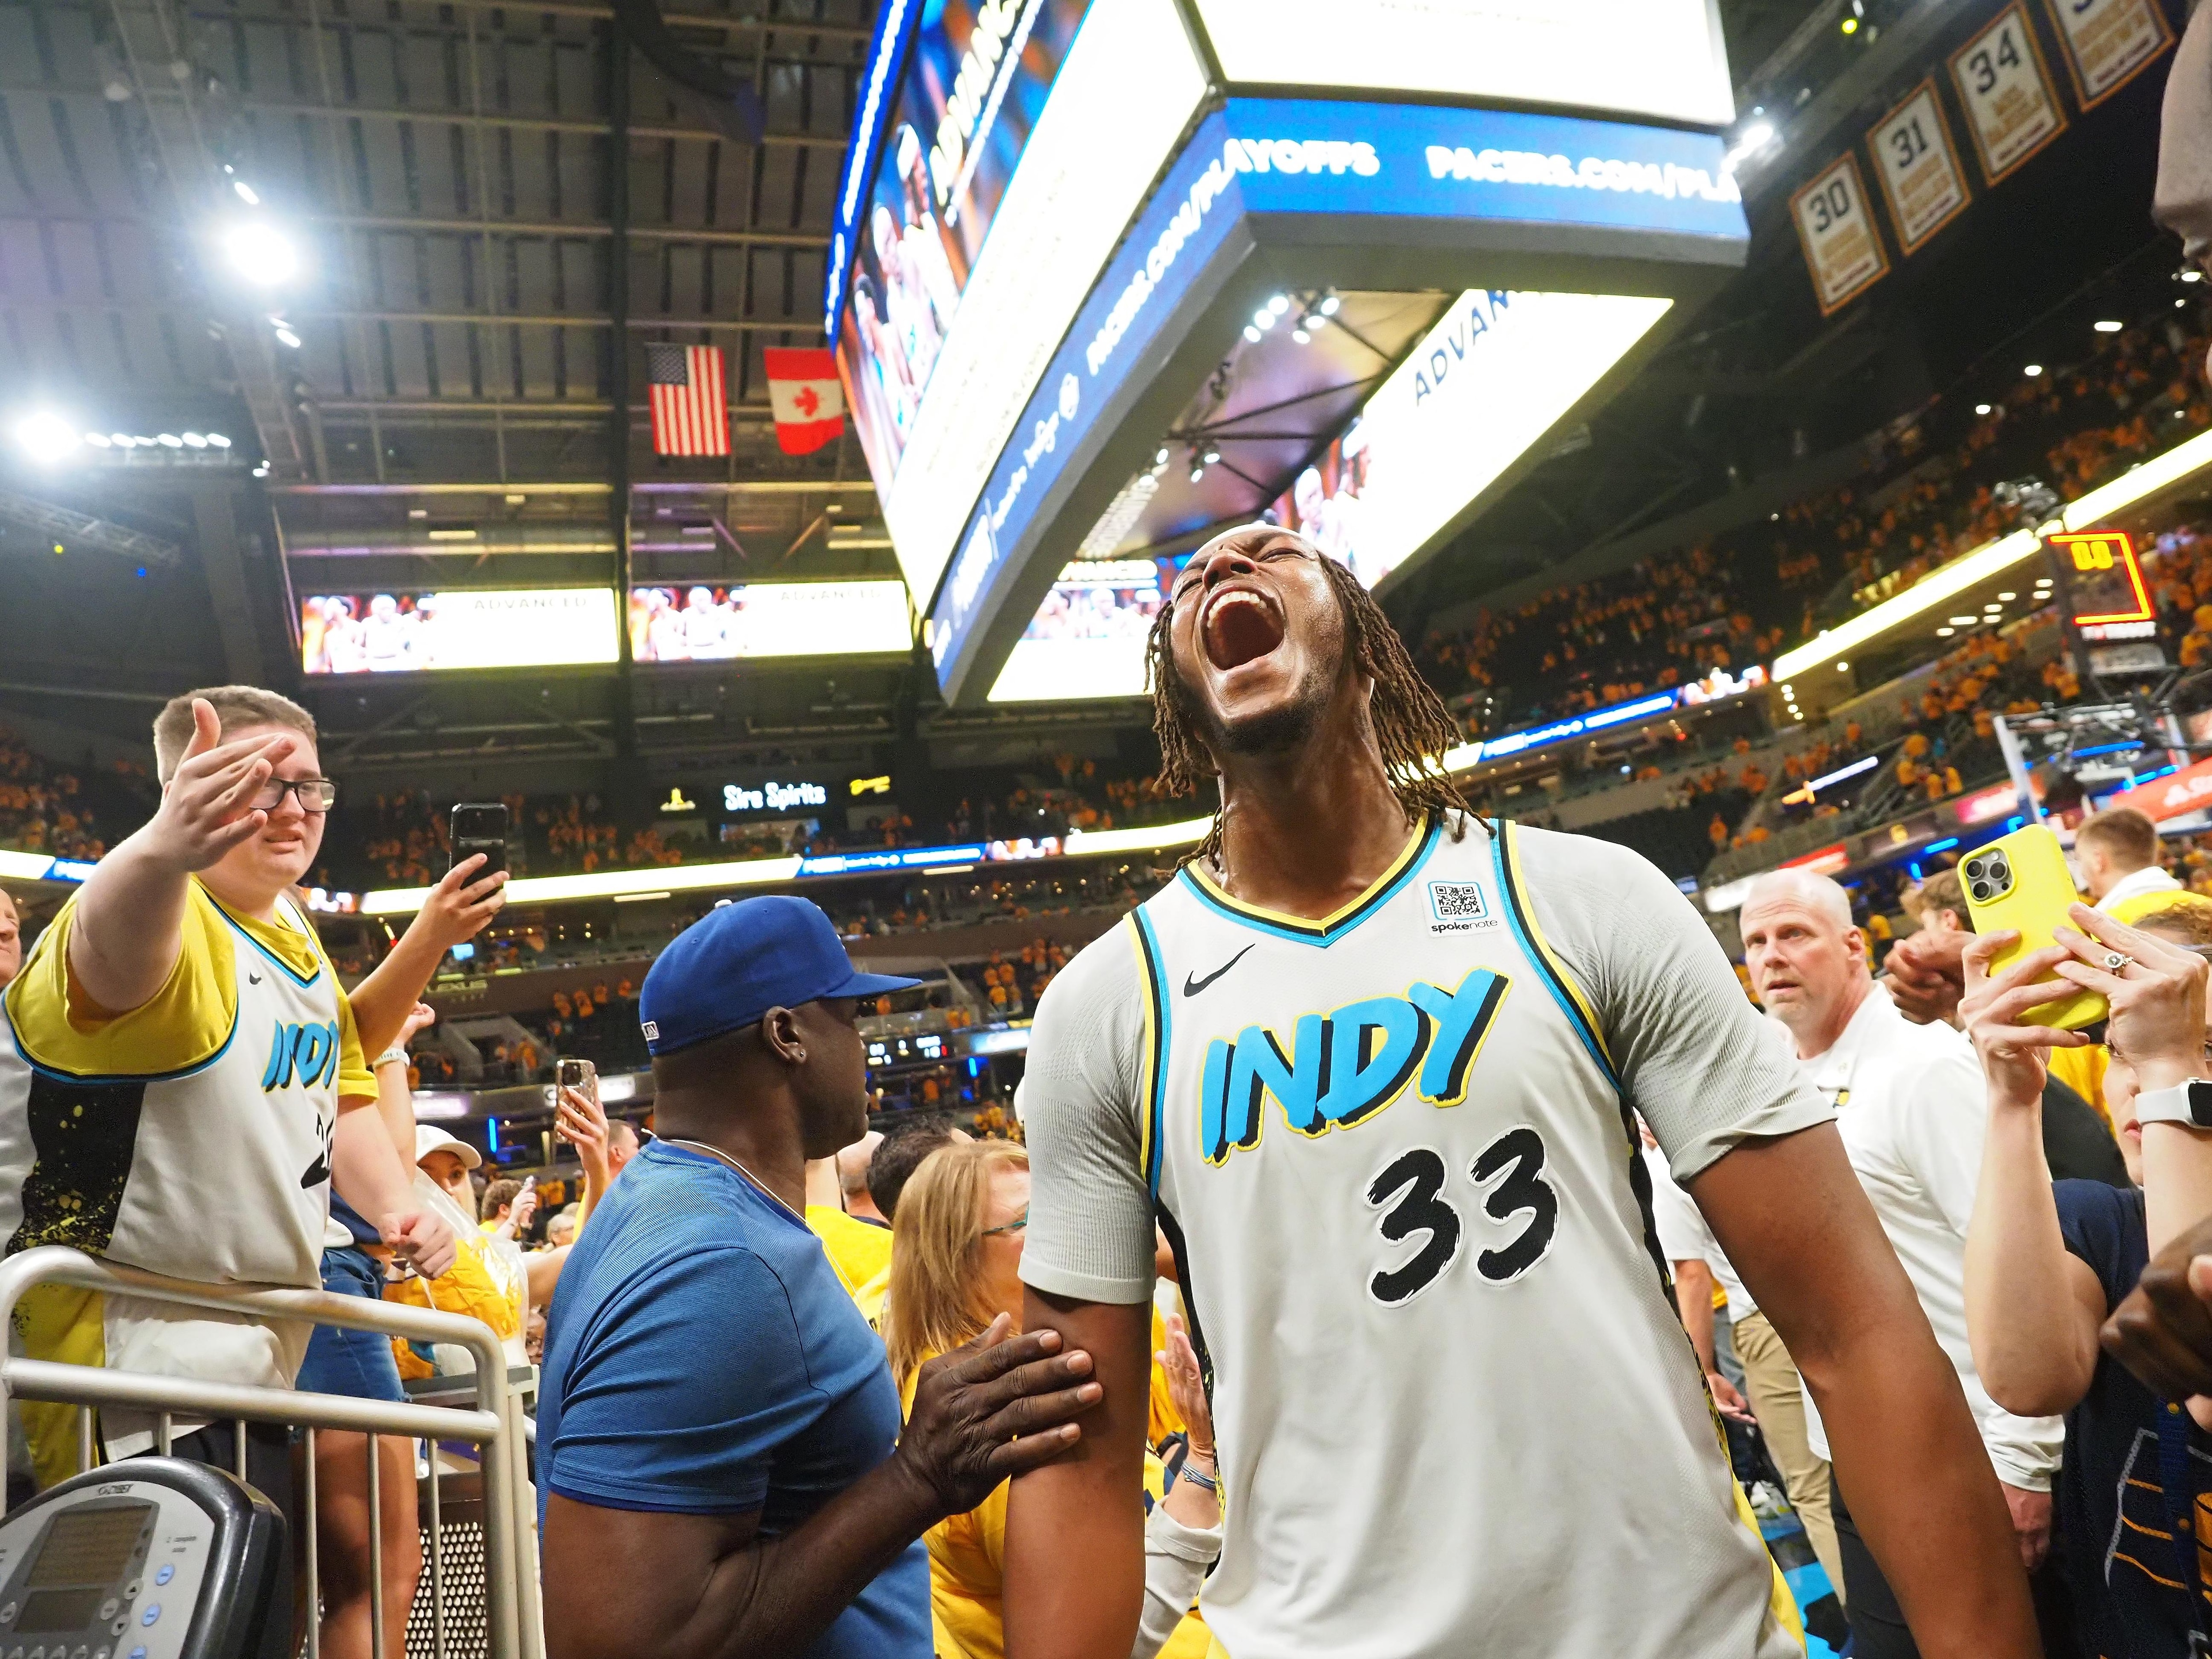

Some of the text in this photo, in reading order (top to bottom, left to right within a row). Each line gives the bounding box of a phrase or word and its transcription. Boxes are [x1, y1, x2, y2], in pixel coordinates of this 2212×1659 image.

[1969, 27, 2020, 95] 34
[1890, 115, 1929, 169] 31
[1809, 179, 1850, 232] 30
[765, 782, 826, 811] Spirits
[1431, 920, 1498, 933] spokenote
[1199, 965, 1513, 1168] INDY
[1364, 1124, 1562, 1309] 33
